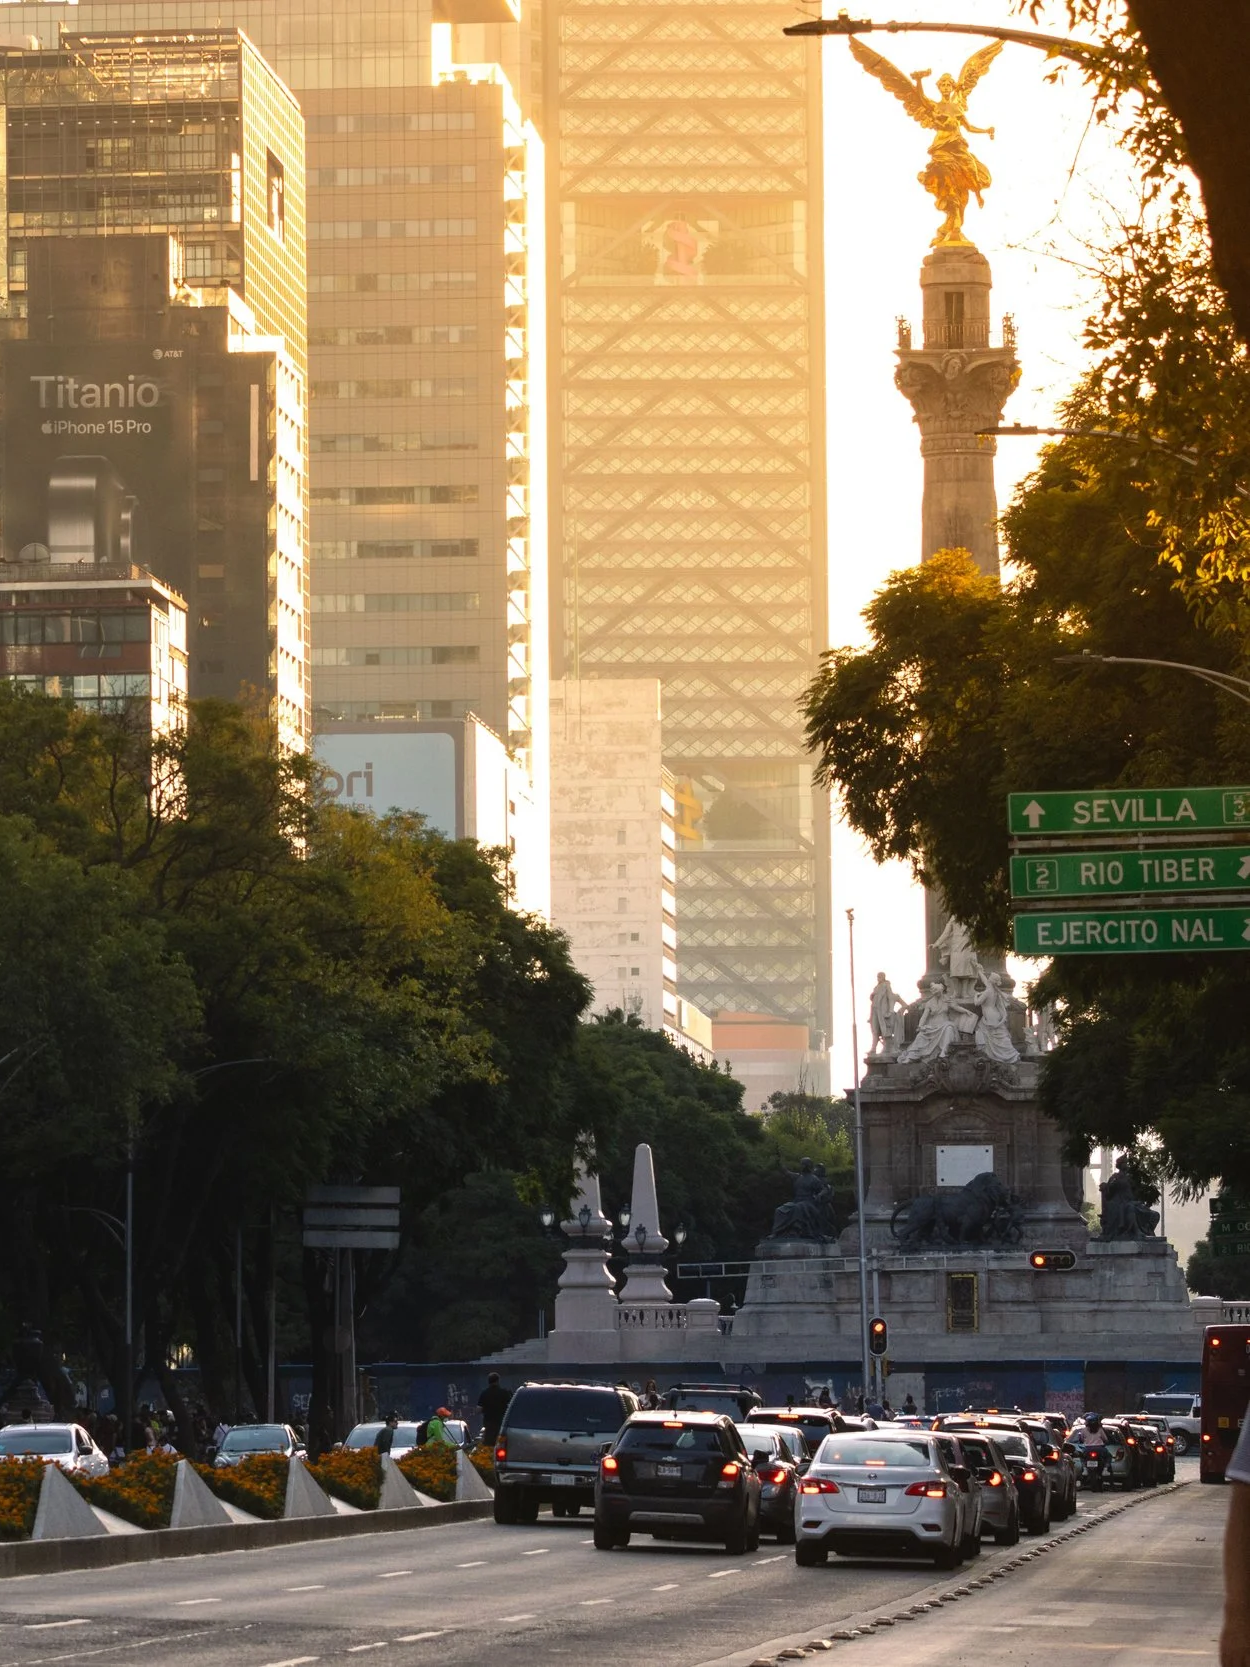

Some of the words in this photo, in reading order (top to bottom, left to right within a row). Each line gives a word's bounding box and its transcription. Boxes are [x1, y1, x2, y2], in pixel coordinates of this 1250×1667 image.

[164, 350, 183, 358] AT&T
[30, 375, 159, 408] Titanio
[54, 420, 105, 434] iPhone
[107, 420, 123, 434] 15
[127, 420, 151, 434] Pro
[1073, 799, 1197, 824] SEVILLA
[1233, 799, 1246, 817] 3
[1036, 868, 1050, 884] 2
[1080, 861, 1123, 886] RIO
[1138, 858, 1215, 883] TIBER
[1037, 920, 1158, 945] EJERCITO
[1172, 919, 1223, 943] NAL
